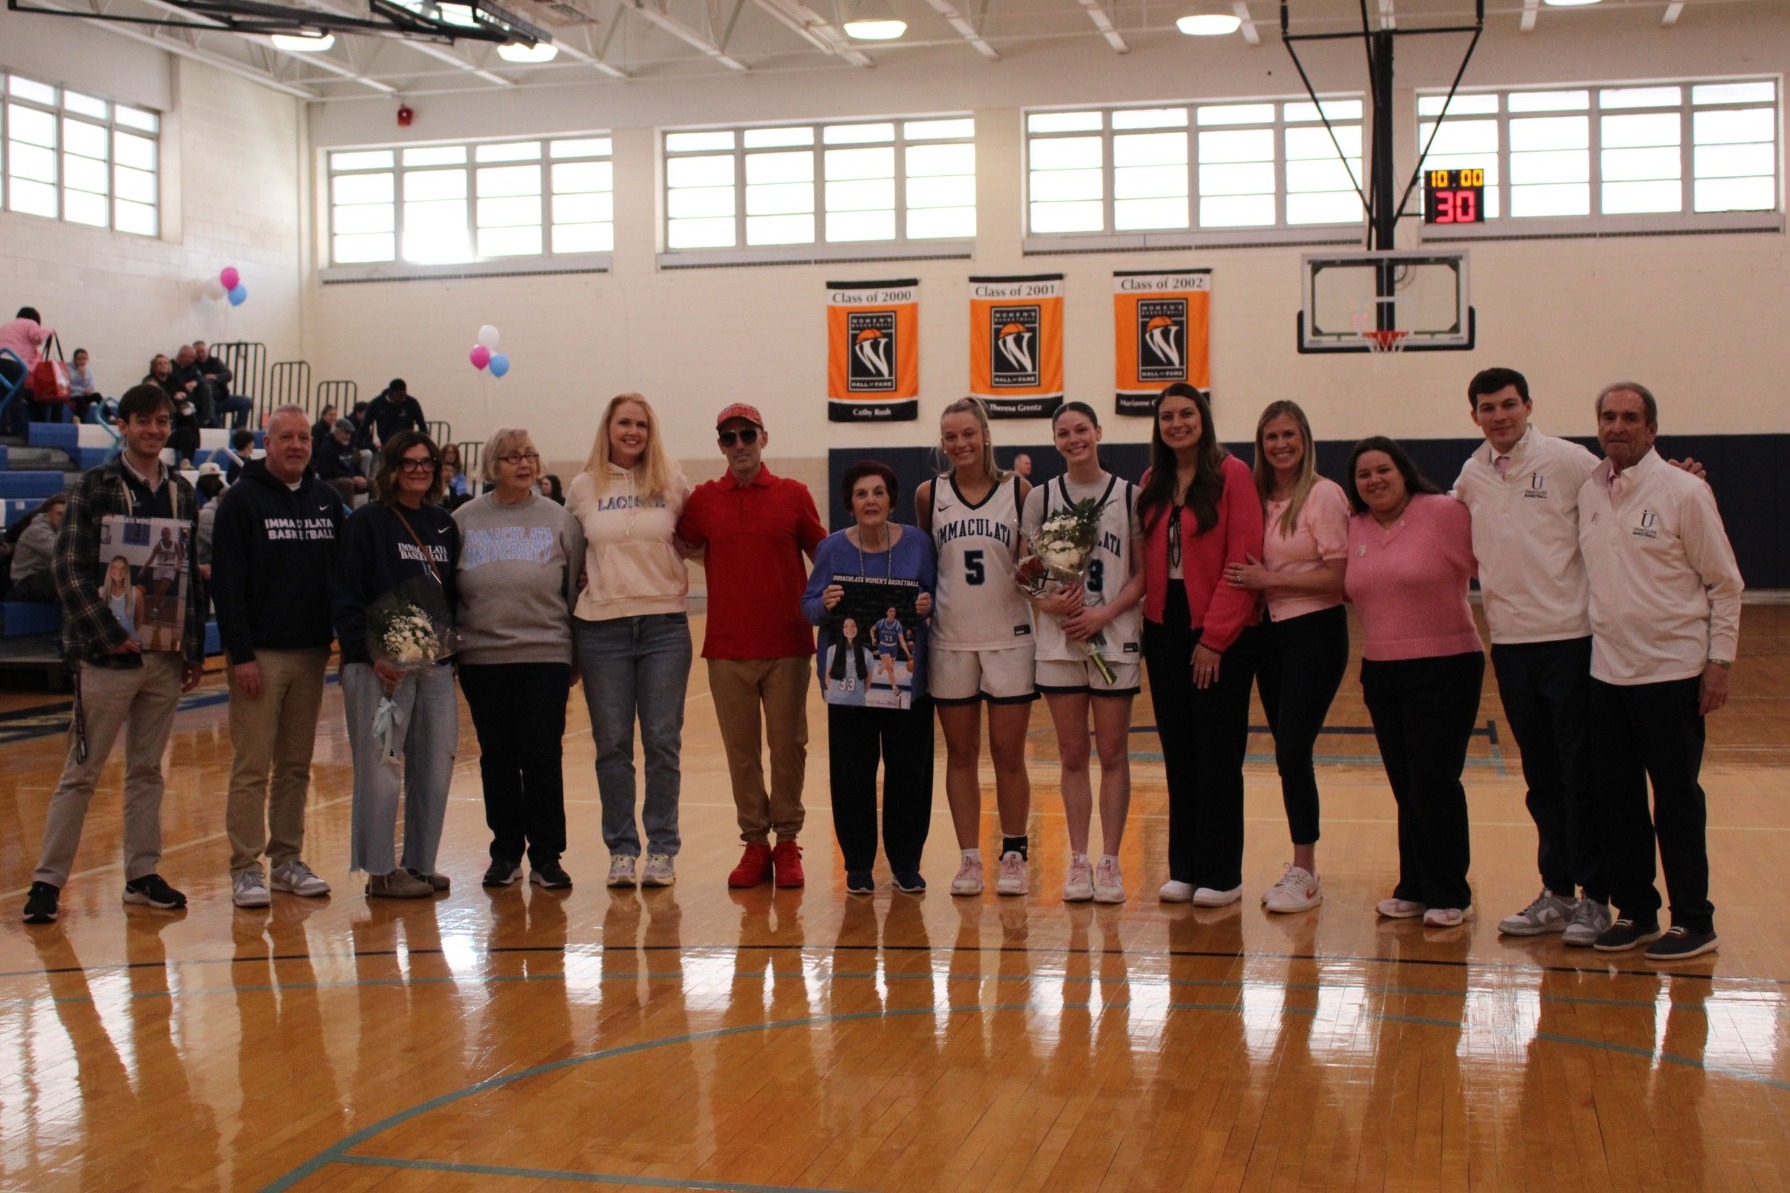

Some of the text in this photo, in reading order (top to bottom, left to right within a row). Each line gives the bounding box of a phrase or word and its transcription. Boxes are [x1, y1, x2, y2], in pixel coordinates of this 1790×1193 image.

[1435, 190, 1476, 223] 30
[975, 284, 1055, 297] Class of 2001
[1121, 277, 1203, 291] Class of 2002
[832, 290, 912, 304] Class of 2000
[989, 403, 1042, 412] Theresa Grentz
[1119, 398, 1150, 407] Marianne
[853, 408, 892, 417] Cathy Rush
[937, 518, 1011, 549] IMMACULATA
[963, 550, 985, 586] 5
[832, 574, 919, 587] IMMACULATA WOMEN'S BASKETBALL
